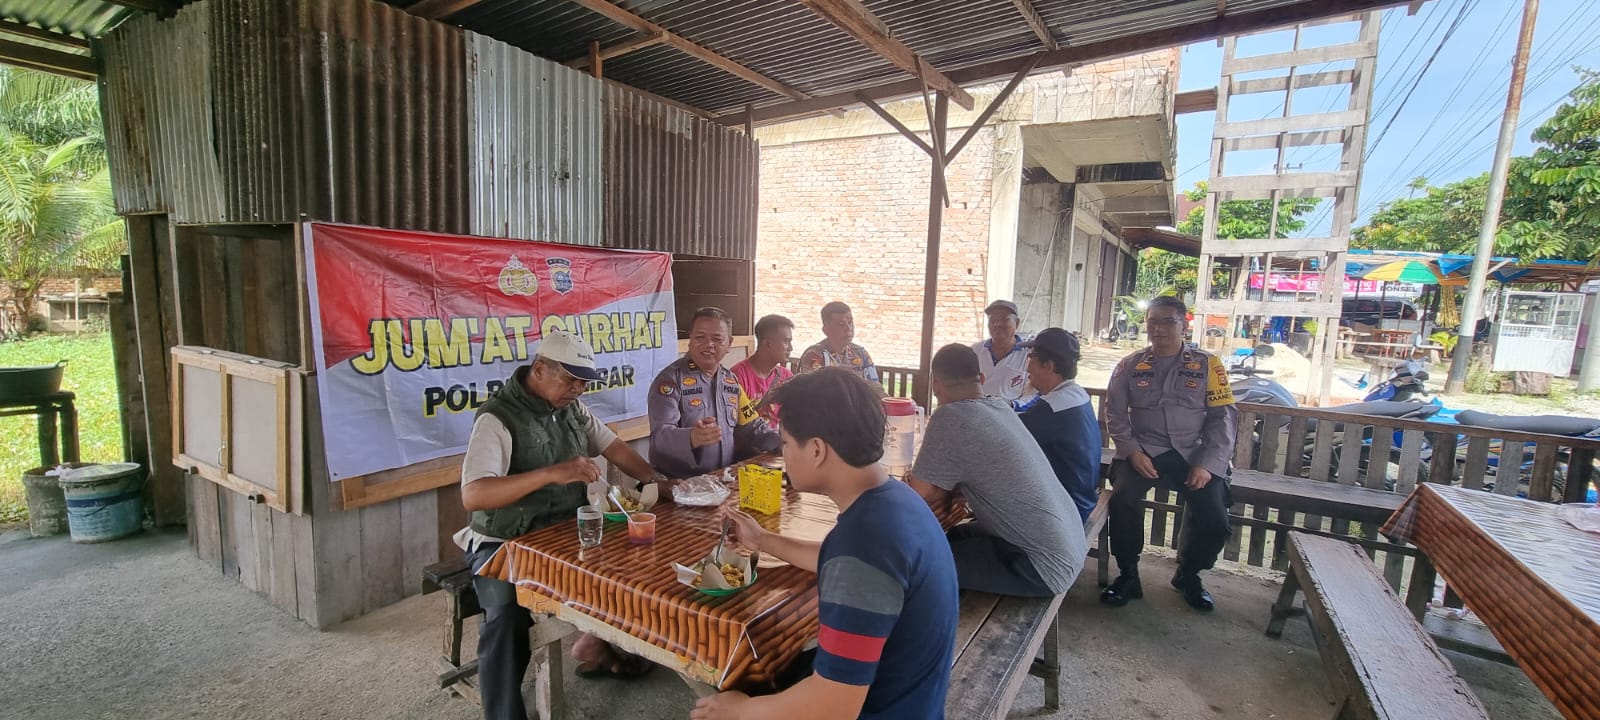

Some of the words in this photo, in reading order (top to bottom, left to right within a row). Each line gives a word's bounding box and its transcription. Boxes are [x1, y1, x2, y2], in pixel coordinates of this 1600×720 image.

[350, 315, 532, 375] JUM'AT
[541, 311, 666, 354] CURHAT
[1178, 371, 1204, 379] POLRI
